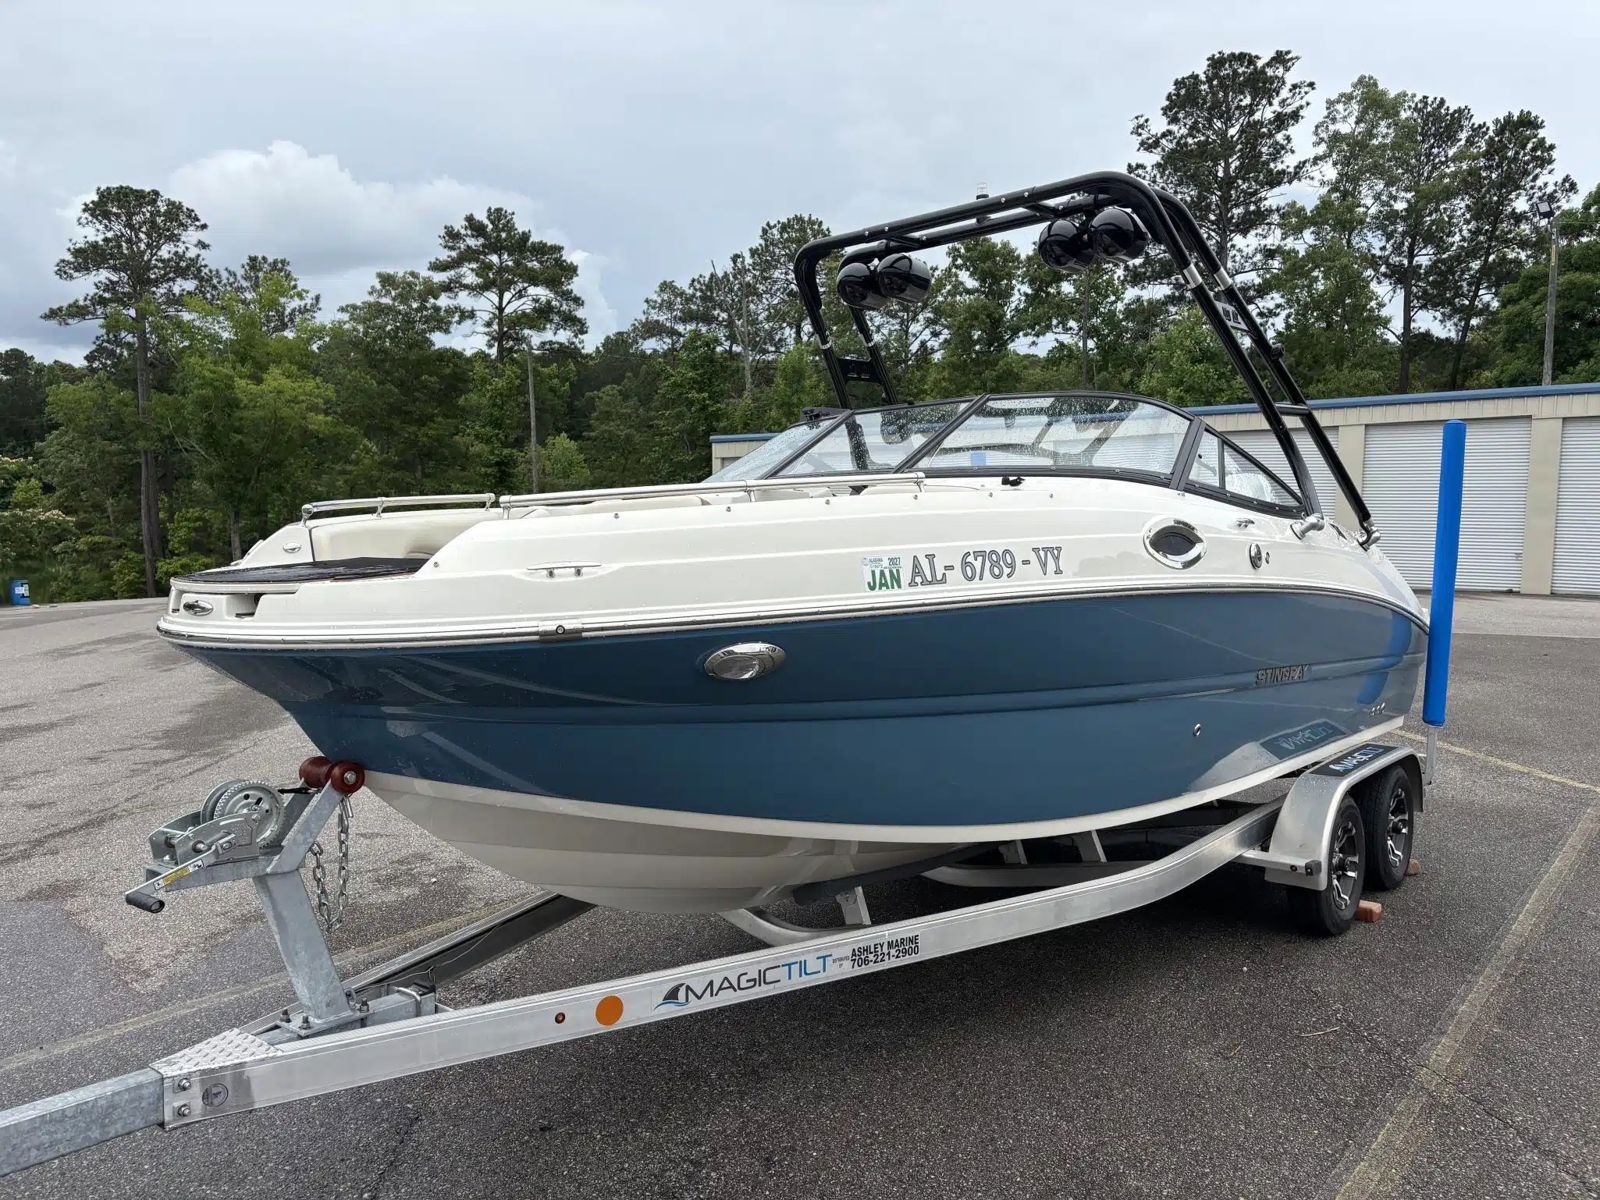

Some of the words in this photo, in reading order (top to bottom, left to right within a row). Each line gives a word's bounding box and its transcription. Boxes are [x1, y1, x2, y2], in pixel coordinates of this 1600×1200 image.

[867, 569, 902, 591] JAN
[850, 945, 919, 969] 706-221-2900
[851, 942, 885, 958] ASHLEY
[887, 935, 919, 950] MARINE
